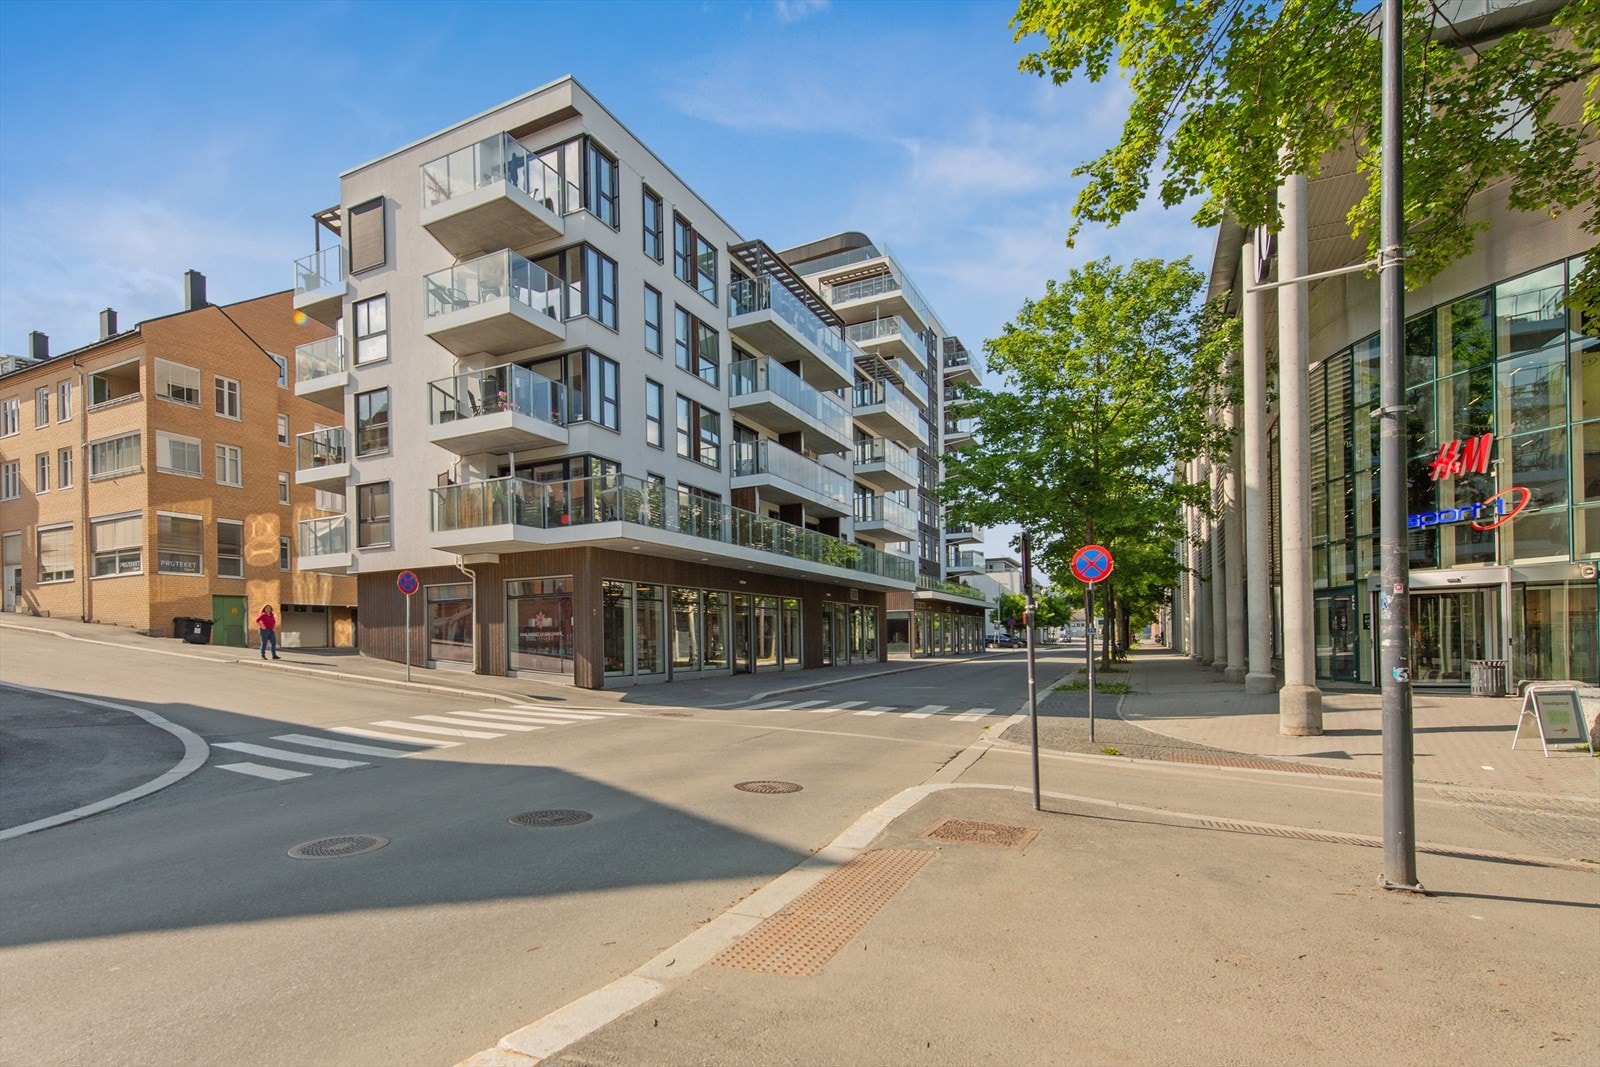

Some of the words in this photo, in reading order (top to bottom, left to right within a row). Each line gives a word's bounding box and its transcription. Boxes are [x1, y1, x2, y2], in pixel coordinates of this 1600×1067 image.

[1430, 432, 1493, 480] H&M
[1407, 502, 1484, 529] sport
[160, 560, 197, 568] PROTEKET
